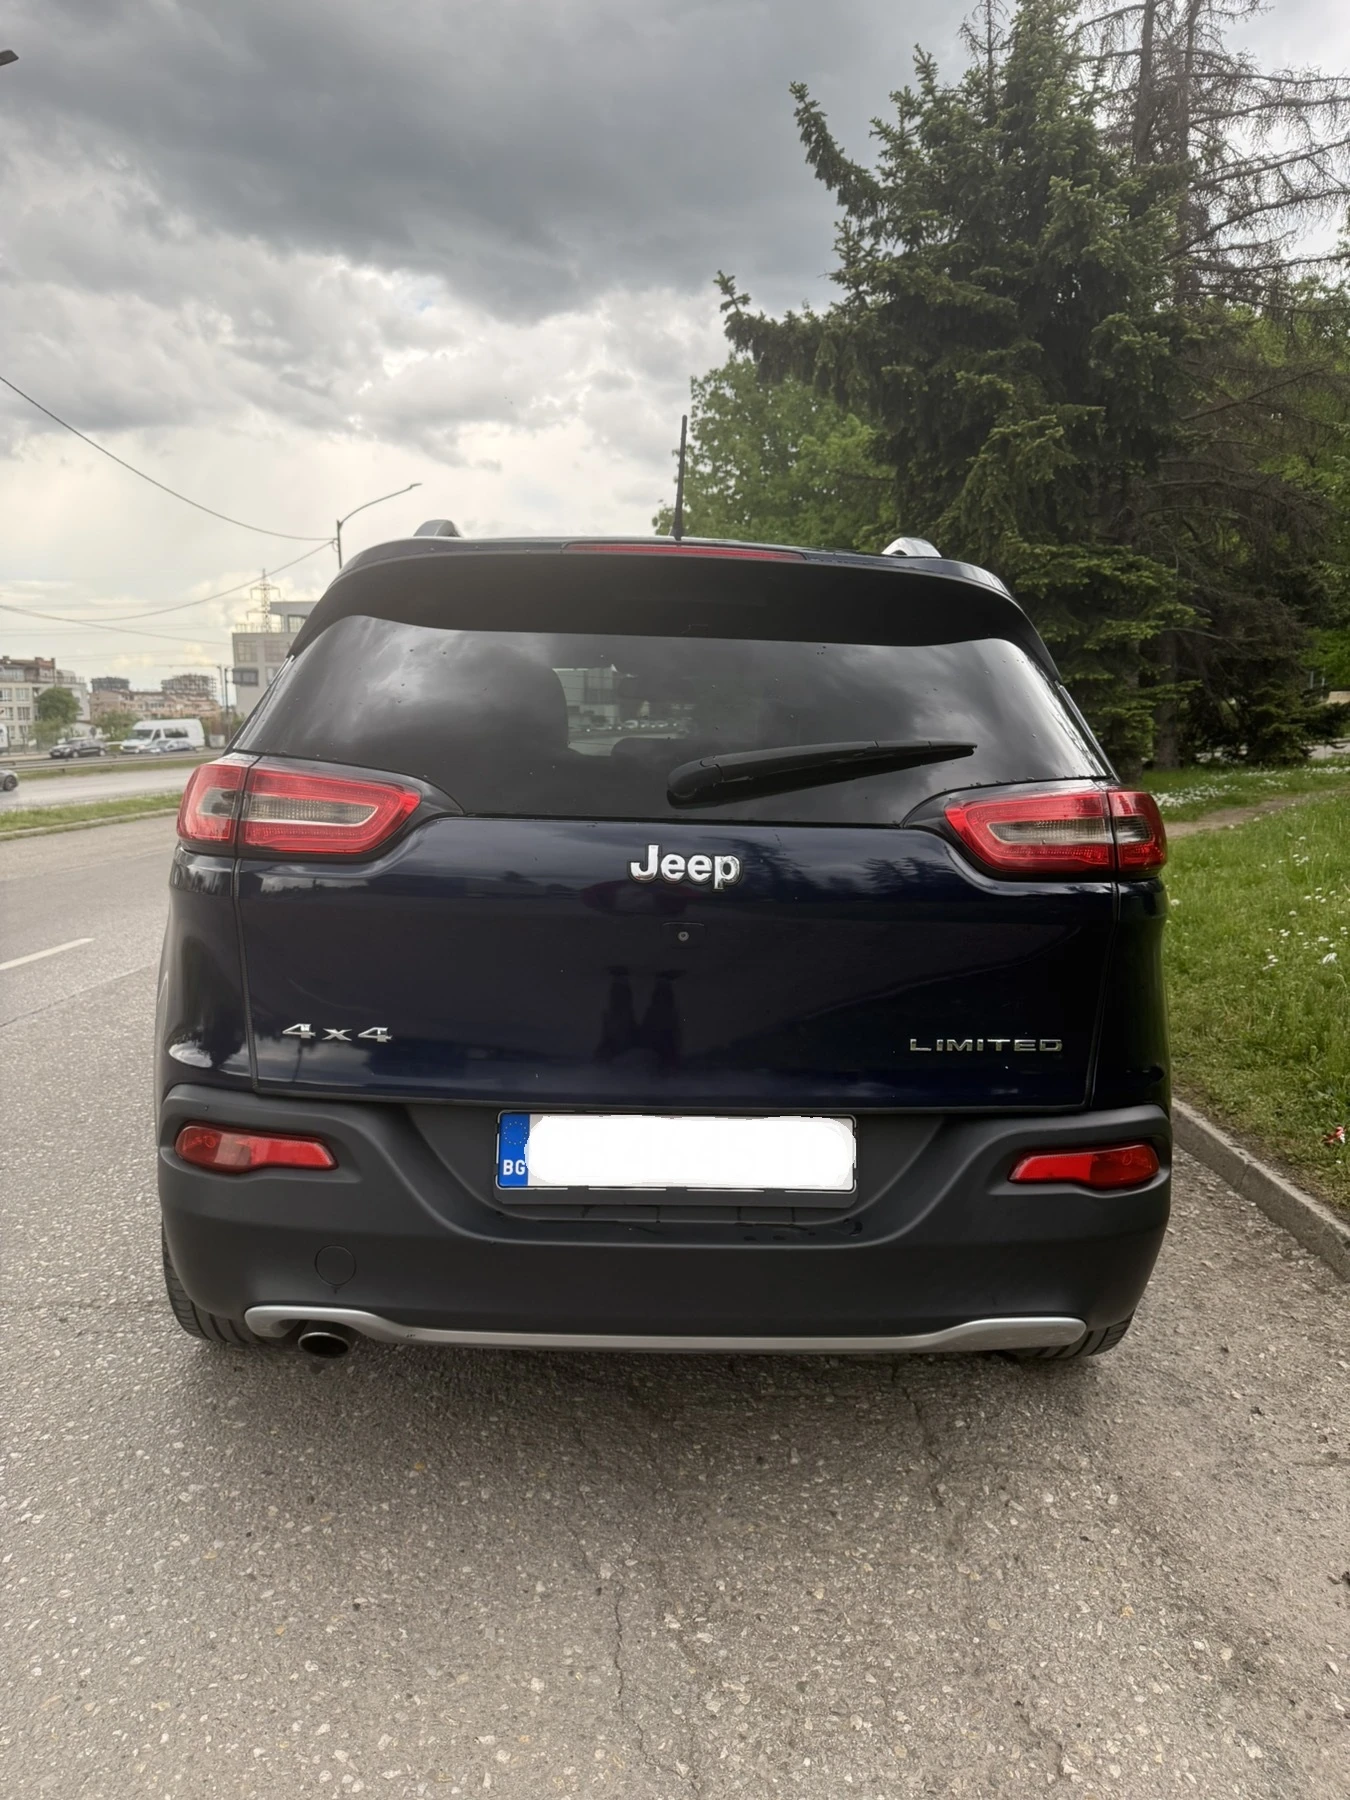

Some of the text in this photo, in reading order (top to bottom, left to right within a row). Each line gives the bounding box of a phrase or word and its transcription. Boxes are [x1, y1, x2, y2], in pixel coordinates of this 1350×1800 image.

[630, 844, 740, 890] Jeep
[910, 1038, 1063, 1052] LIMITED
[503, 1159, 526, 1176] BG
